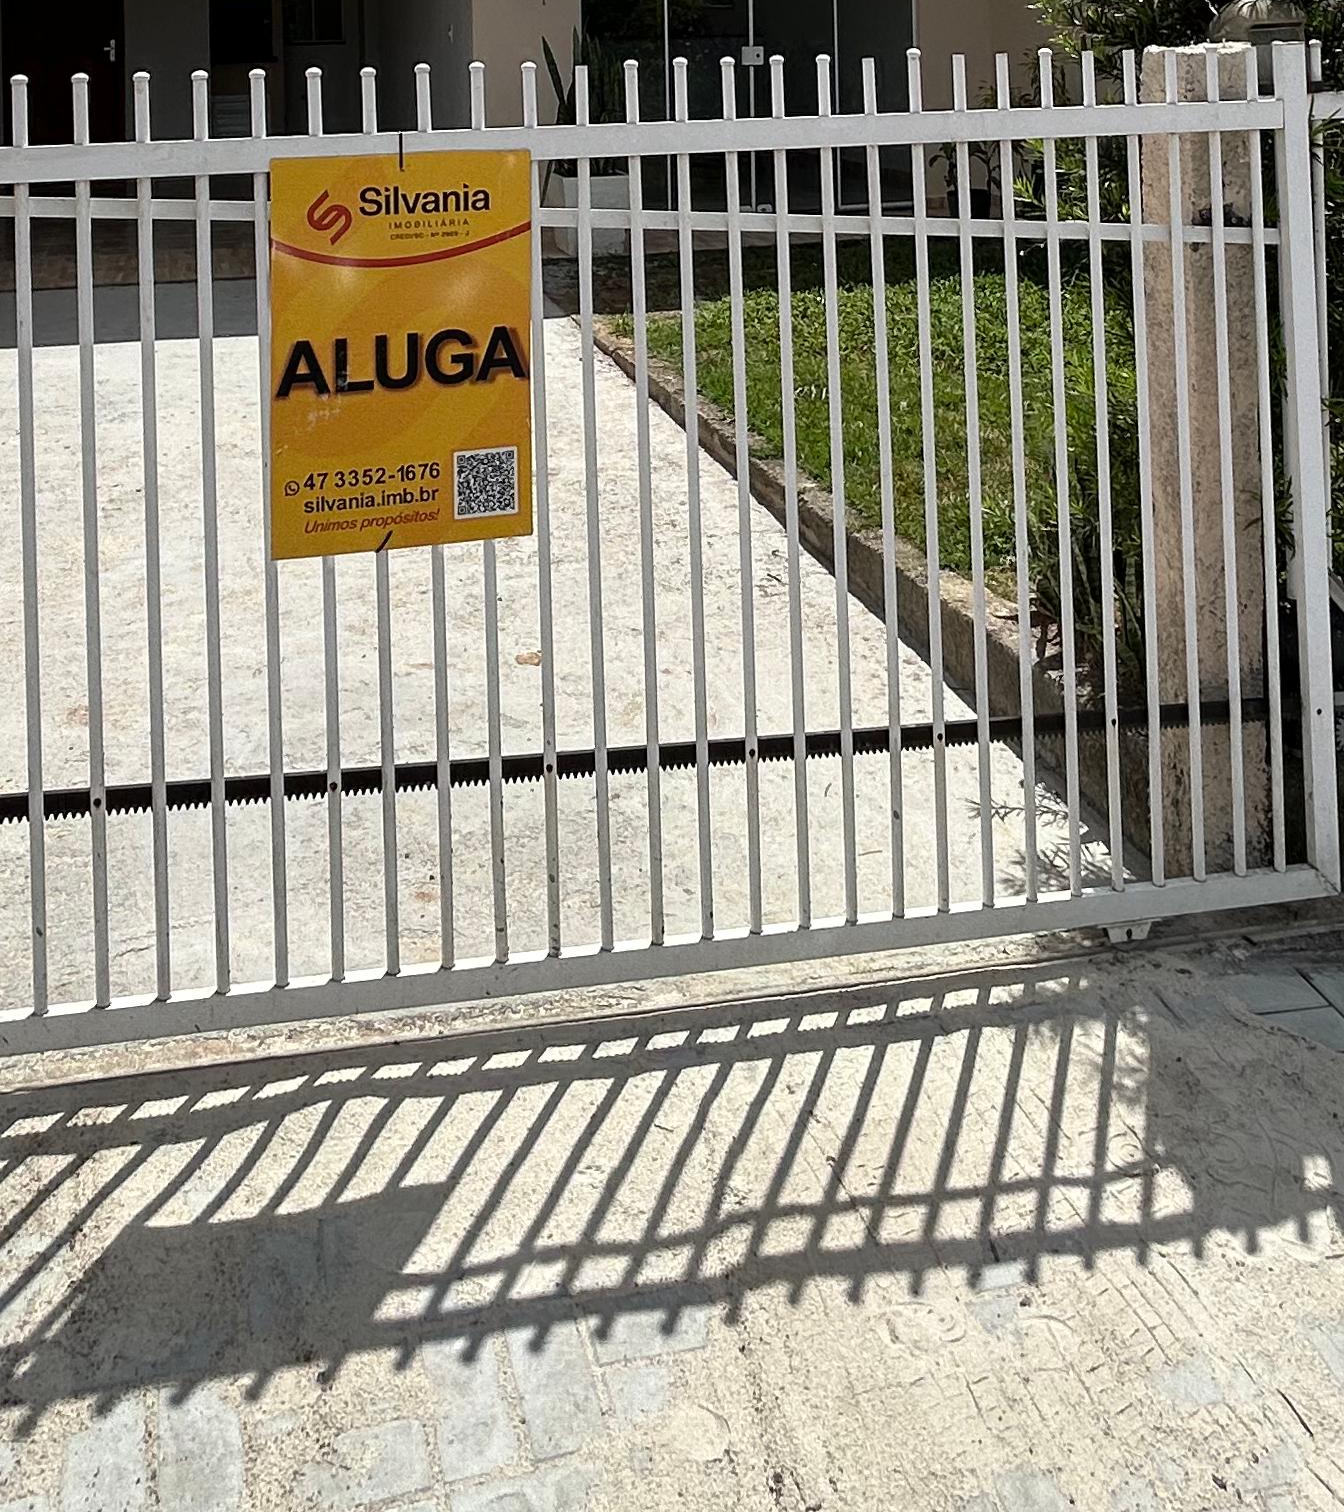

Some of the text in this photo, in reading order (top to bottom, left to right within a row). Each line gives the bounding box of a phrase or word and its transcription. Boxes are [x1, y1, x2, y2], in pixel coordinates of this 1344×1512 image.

[359, 183, 491, 217] Silvania
[275, 325, 527, 398] ALUGA
[303, 462, 440, 491] 47 3352-1676
[304, 486, 439, 514] silvania.imb.br
[304, 508, 441, 534] Unimos propósitos!
